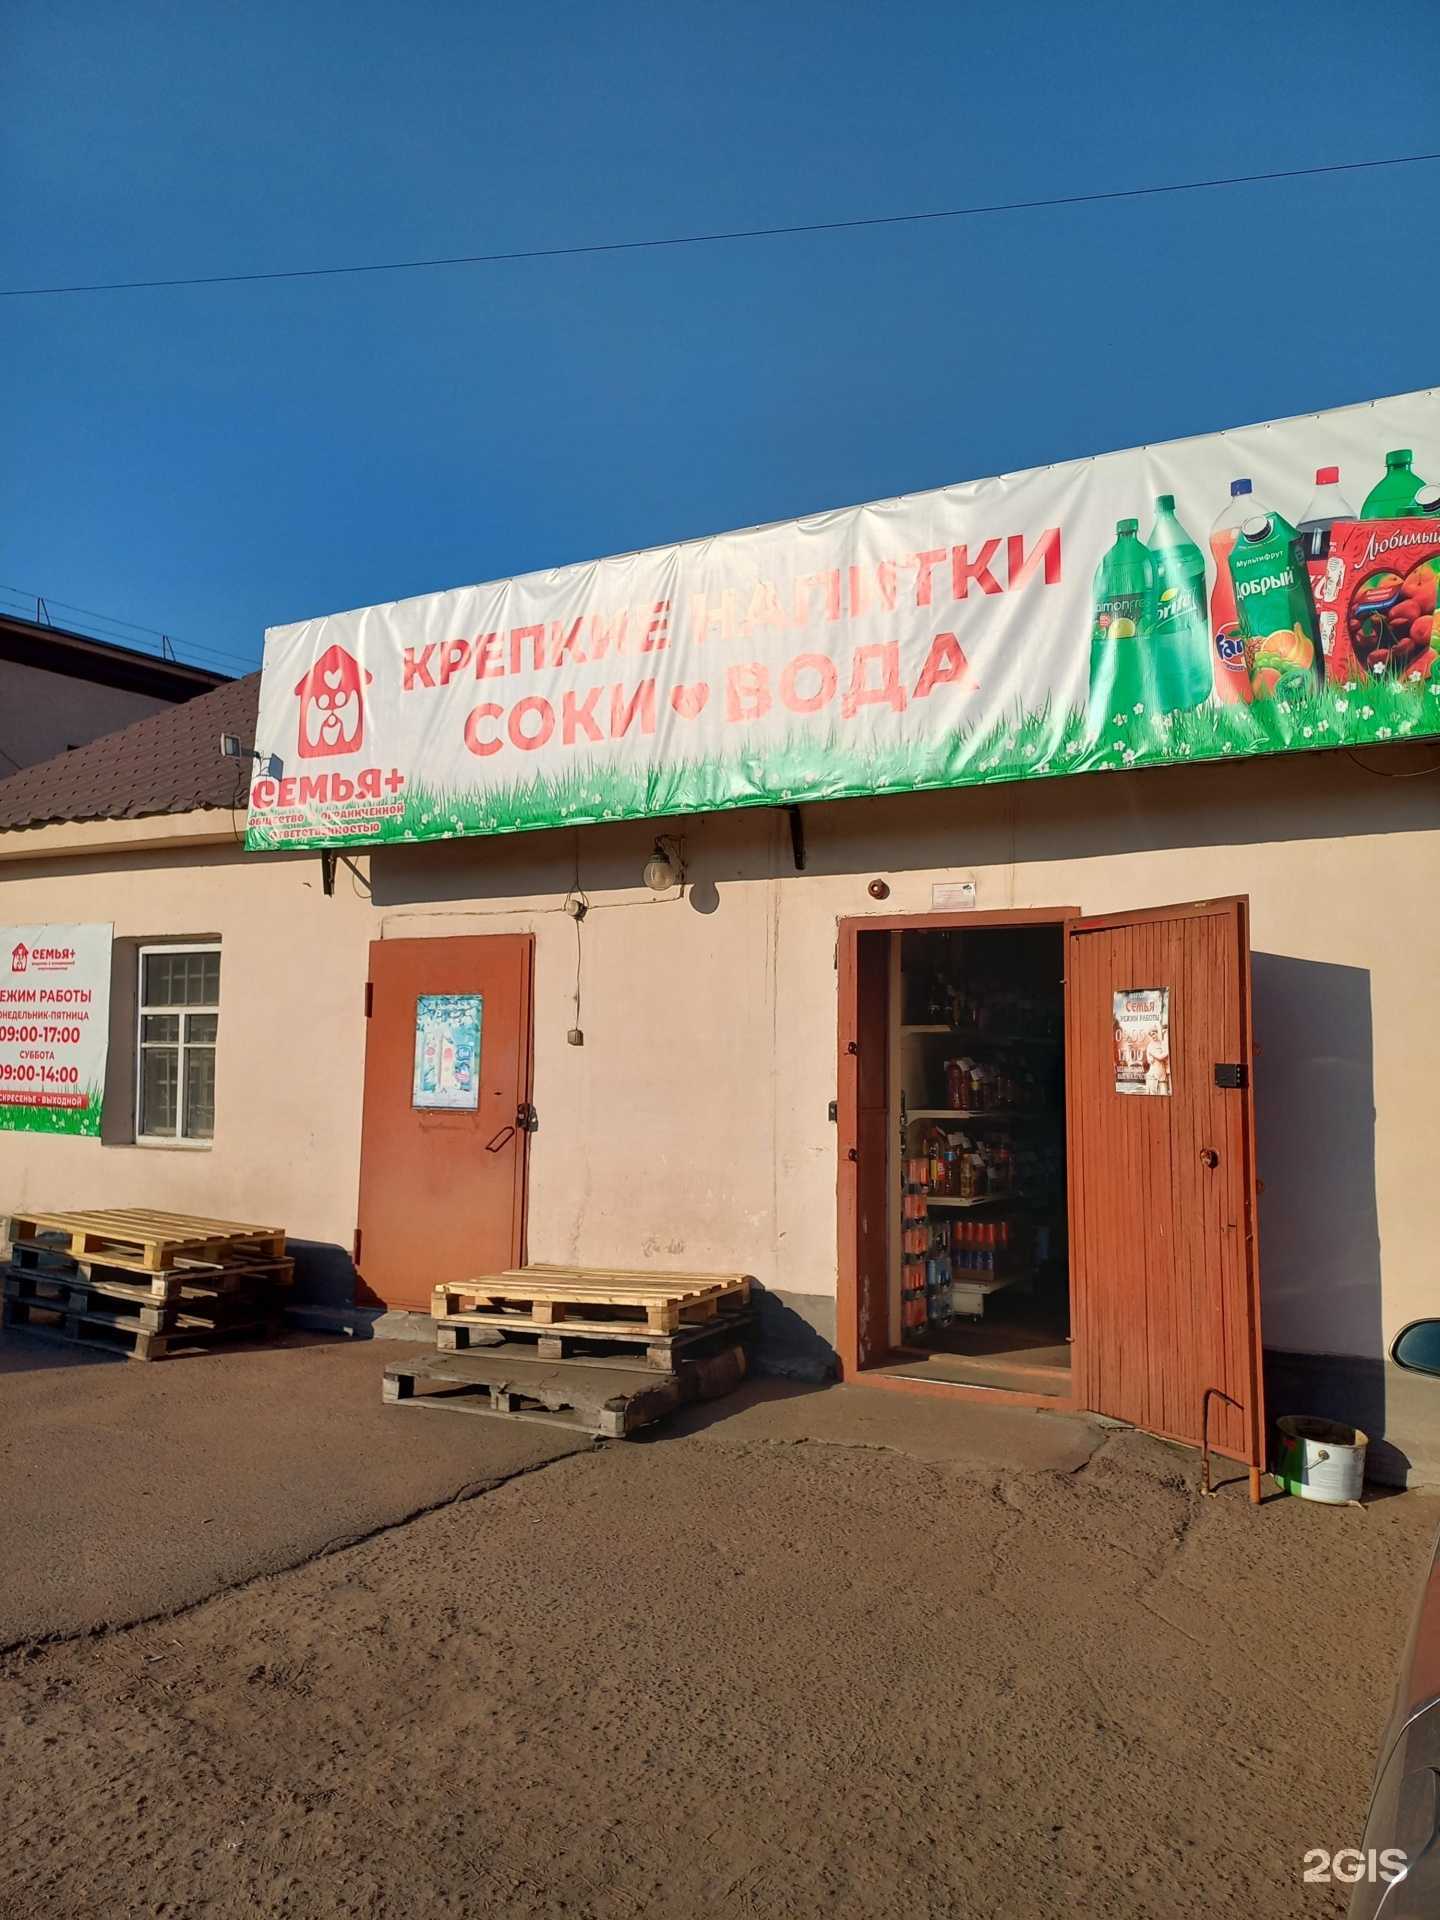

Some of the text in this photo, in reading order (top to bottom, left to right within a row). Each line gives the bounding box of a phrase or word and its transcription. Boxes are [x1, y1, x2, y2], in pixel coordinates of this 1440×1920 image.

[402, 527, 1062, 692] КРЕПКИЕ НАПИТКИ
[463, 632, 981, 757] СОКИ ВОДА
[40, 989, 92, 1003] РАБОТЫ
[0, 1026, 81, 1043] 09:00-17:00
[19, 1050, 55, 1060] СУББОТА
[41, 1095, 82, 1106] ВЫХОДНОЙ
